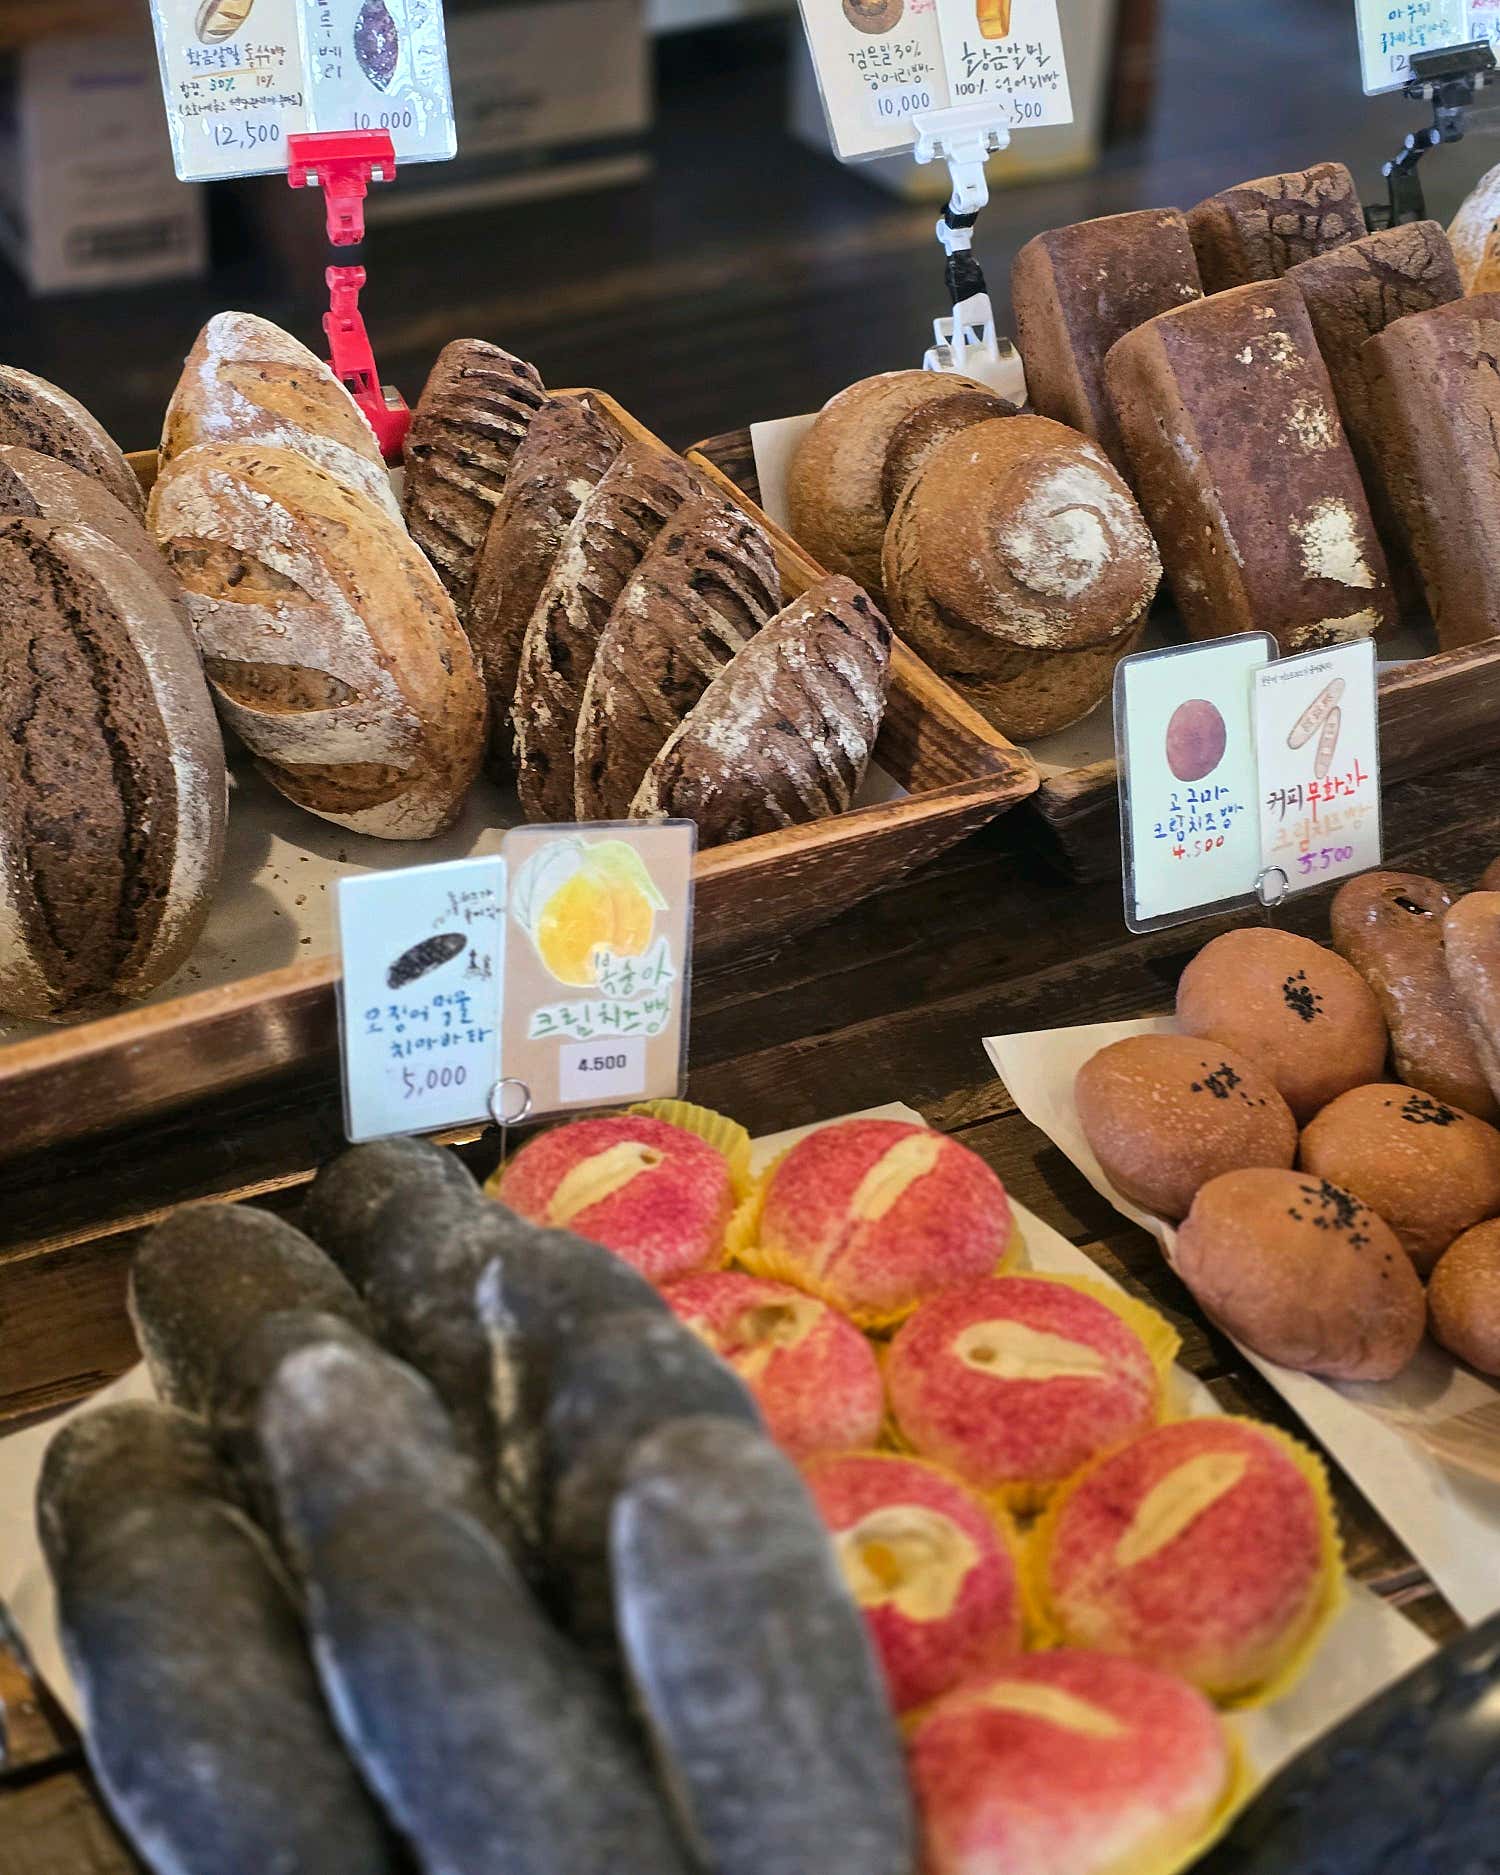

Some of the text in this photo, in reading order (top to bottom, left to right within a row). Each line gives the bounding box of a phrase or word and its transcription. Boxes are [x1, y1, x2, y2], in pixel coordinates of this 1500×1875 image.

[210, 78, 236, 92] 30%
[955, 78, 988, 96] 100%
[878, 92, 930, 117] 10,000
[214, 121, 280, 149] 12,500
[353, 111, 412, 131] 10000
[1169, 784, 1230, 815] 고구마
[1153, 803, 1245, 842] 크림치즈빵
[531, 986, 671, 1039] 크림치즈빵
[389, 1028, 494, 1059] 치아바타
[577, 1053, 628, 1073] 4.500
[402, 1065, 467, 1100] 5,000
